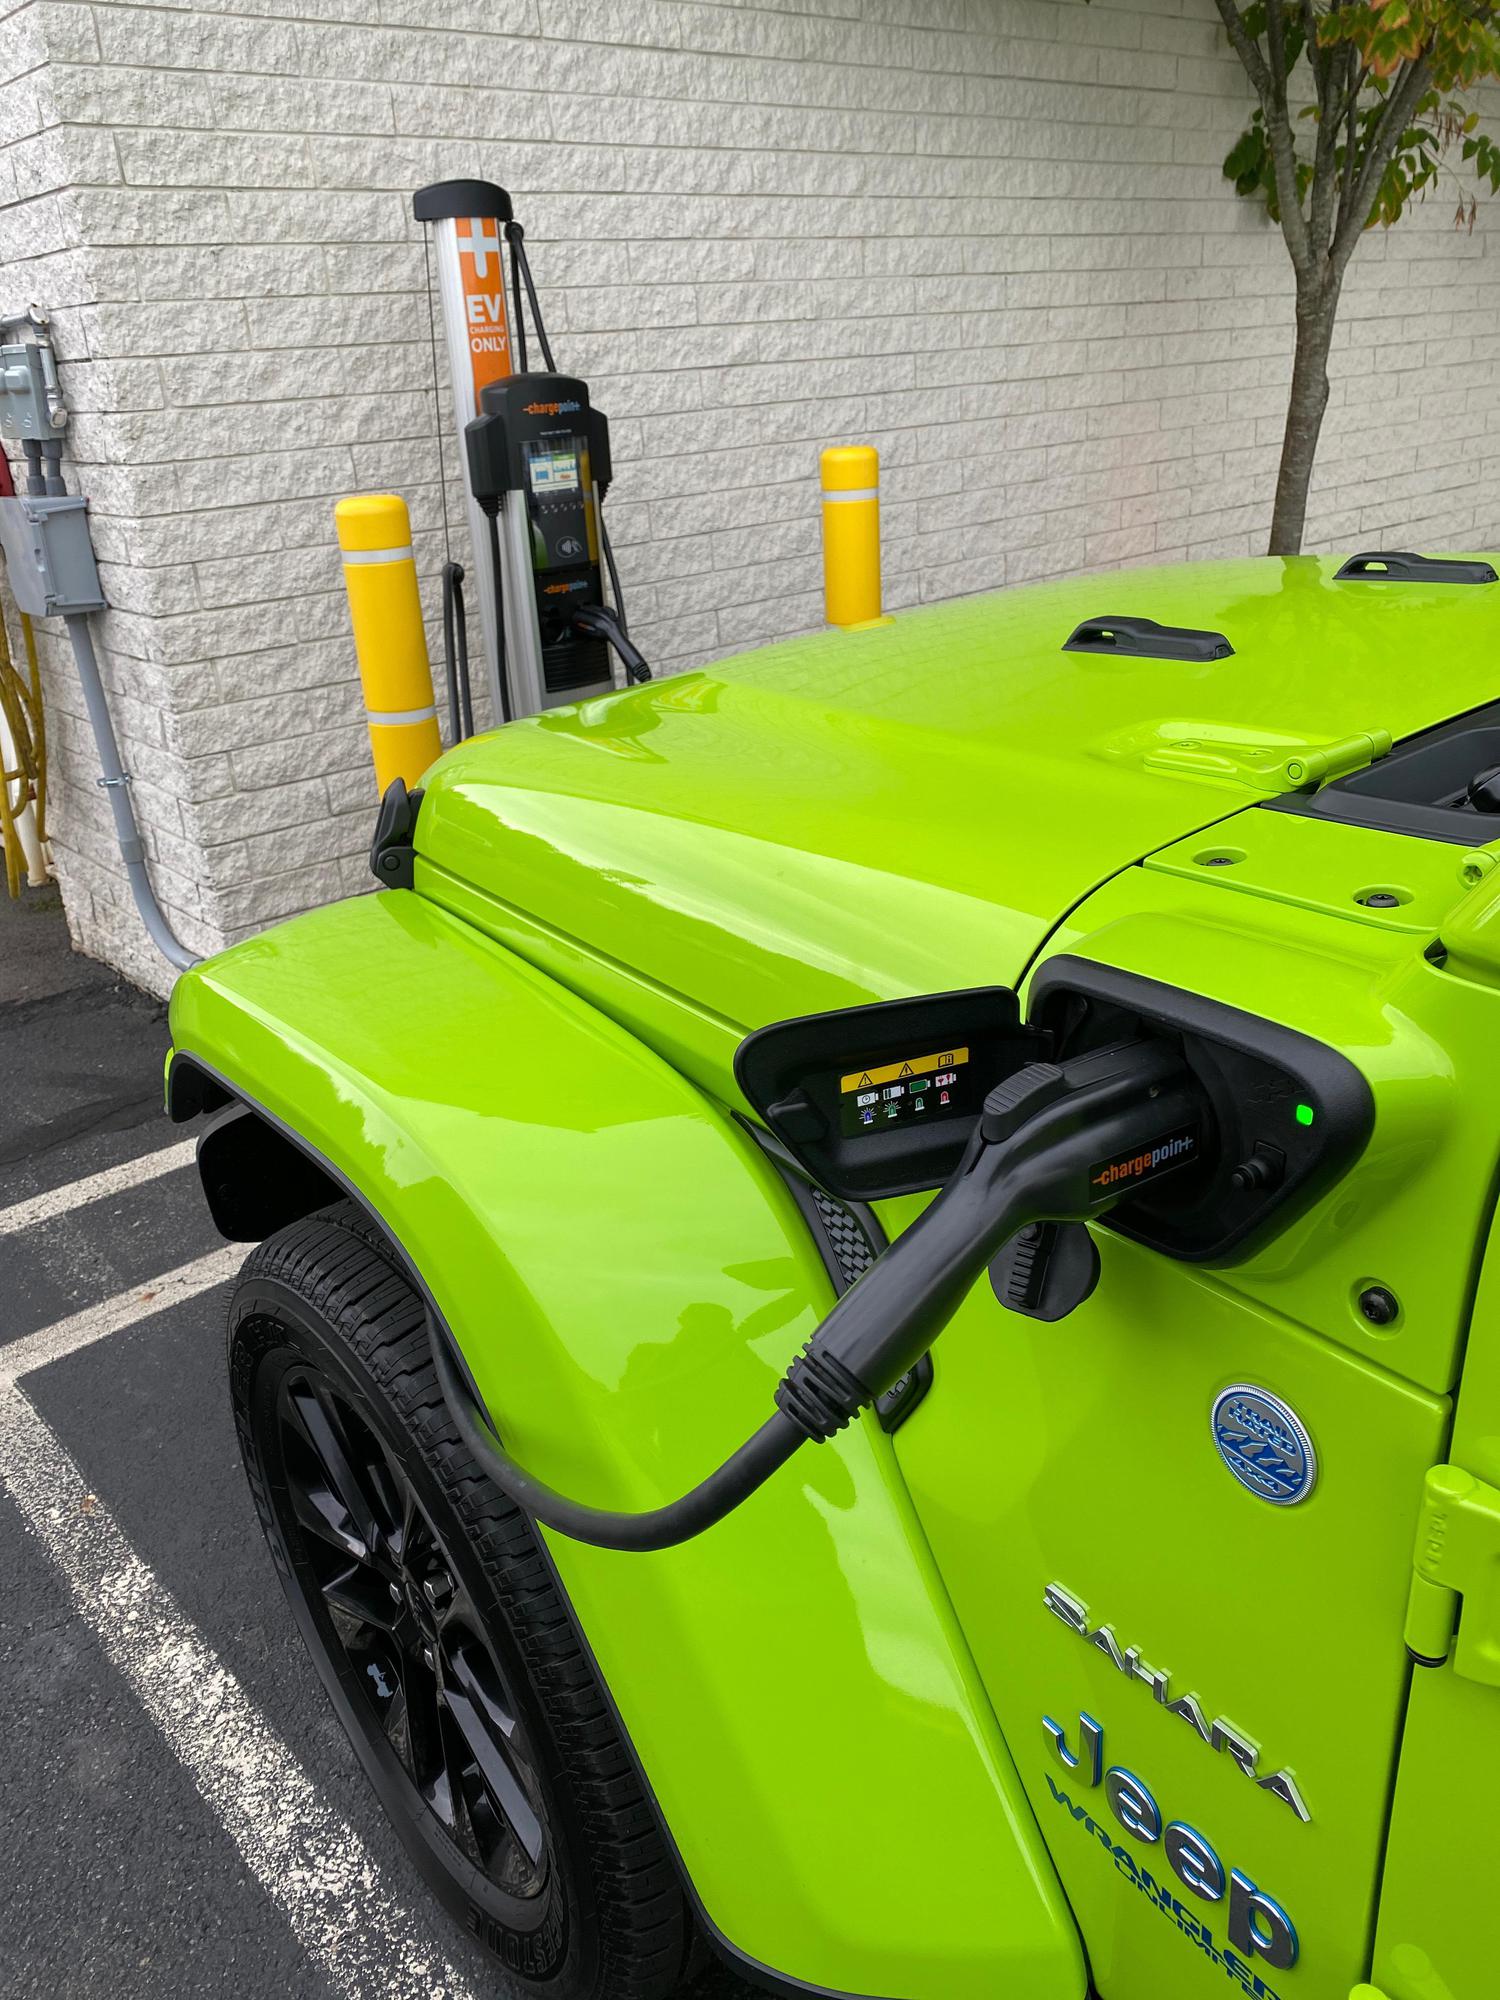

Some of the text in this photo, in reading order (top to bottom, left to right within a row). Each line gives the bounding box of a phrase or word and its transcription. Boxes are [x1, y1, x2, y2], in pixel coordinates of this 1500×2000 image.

[466, 293, 502, 323] EV
[471, 335, 507, 353] ONLY
[1228, 1406, 1298, 1457] RATED
[1233, 1399, 1295, 1447] TRAIL
[1043, 1581, 1313, 1823] SAHARA
[1042, 1710, 1300, 1970] Jeep
[1114, 1858, 1266, 2000] UNLIMITE
